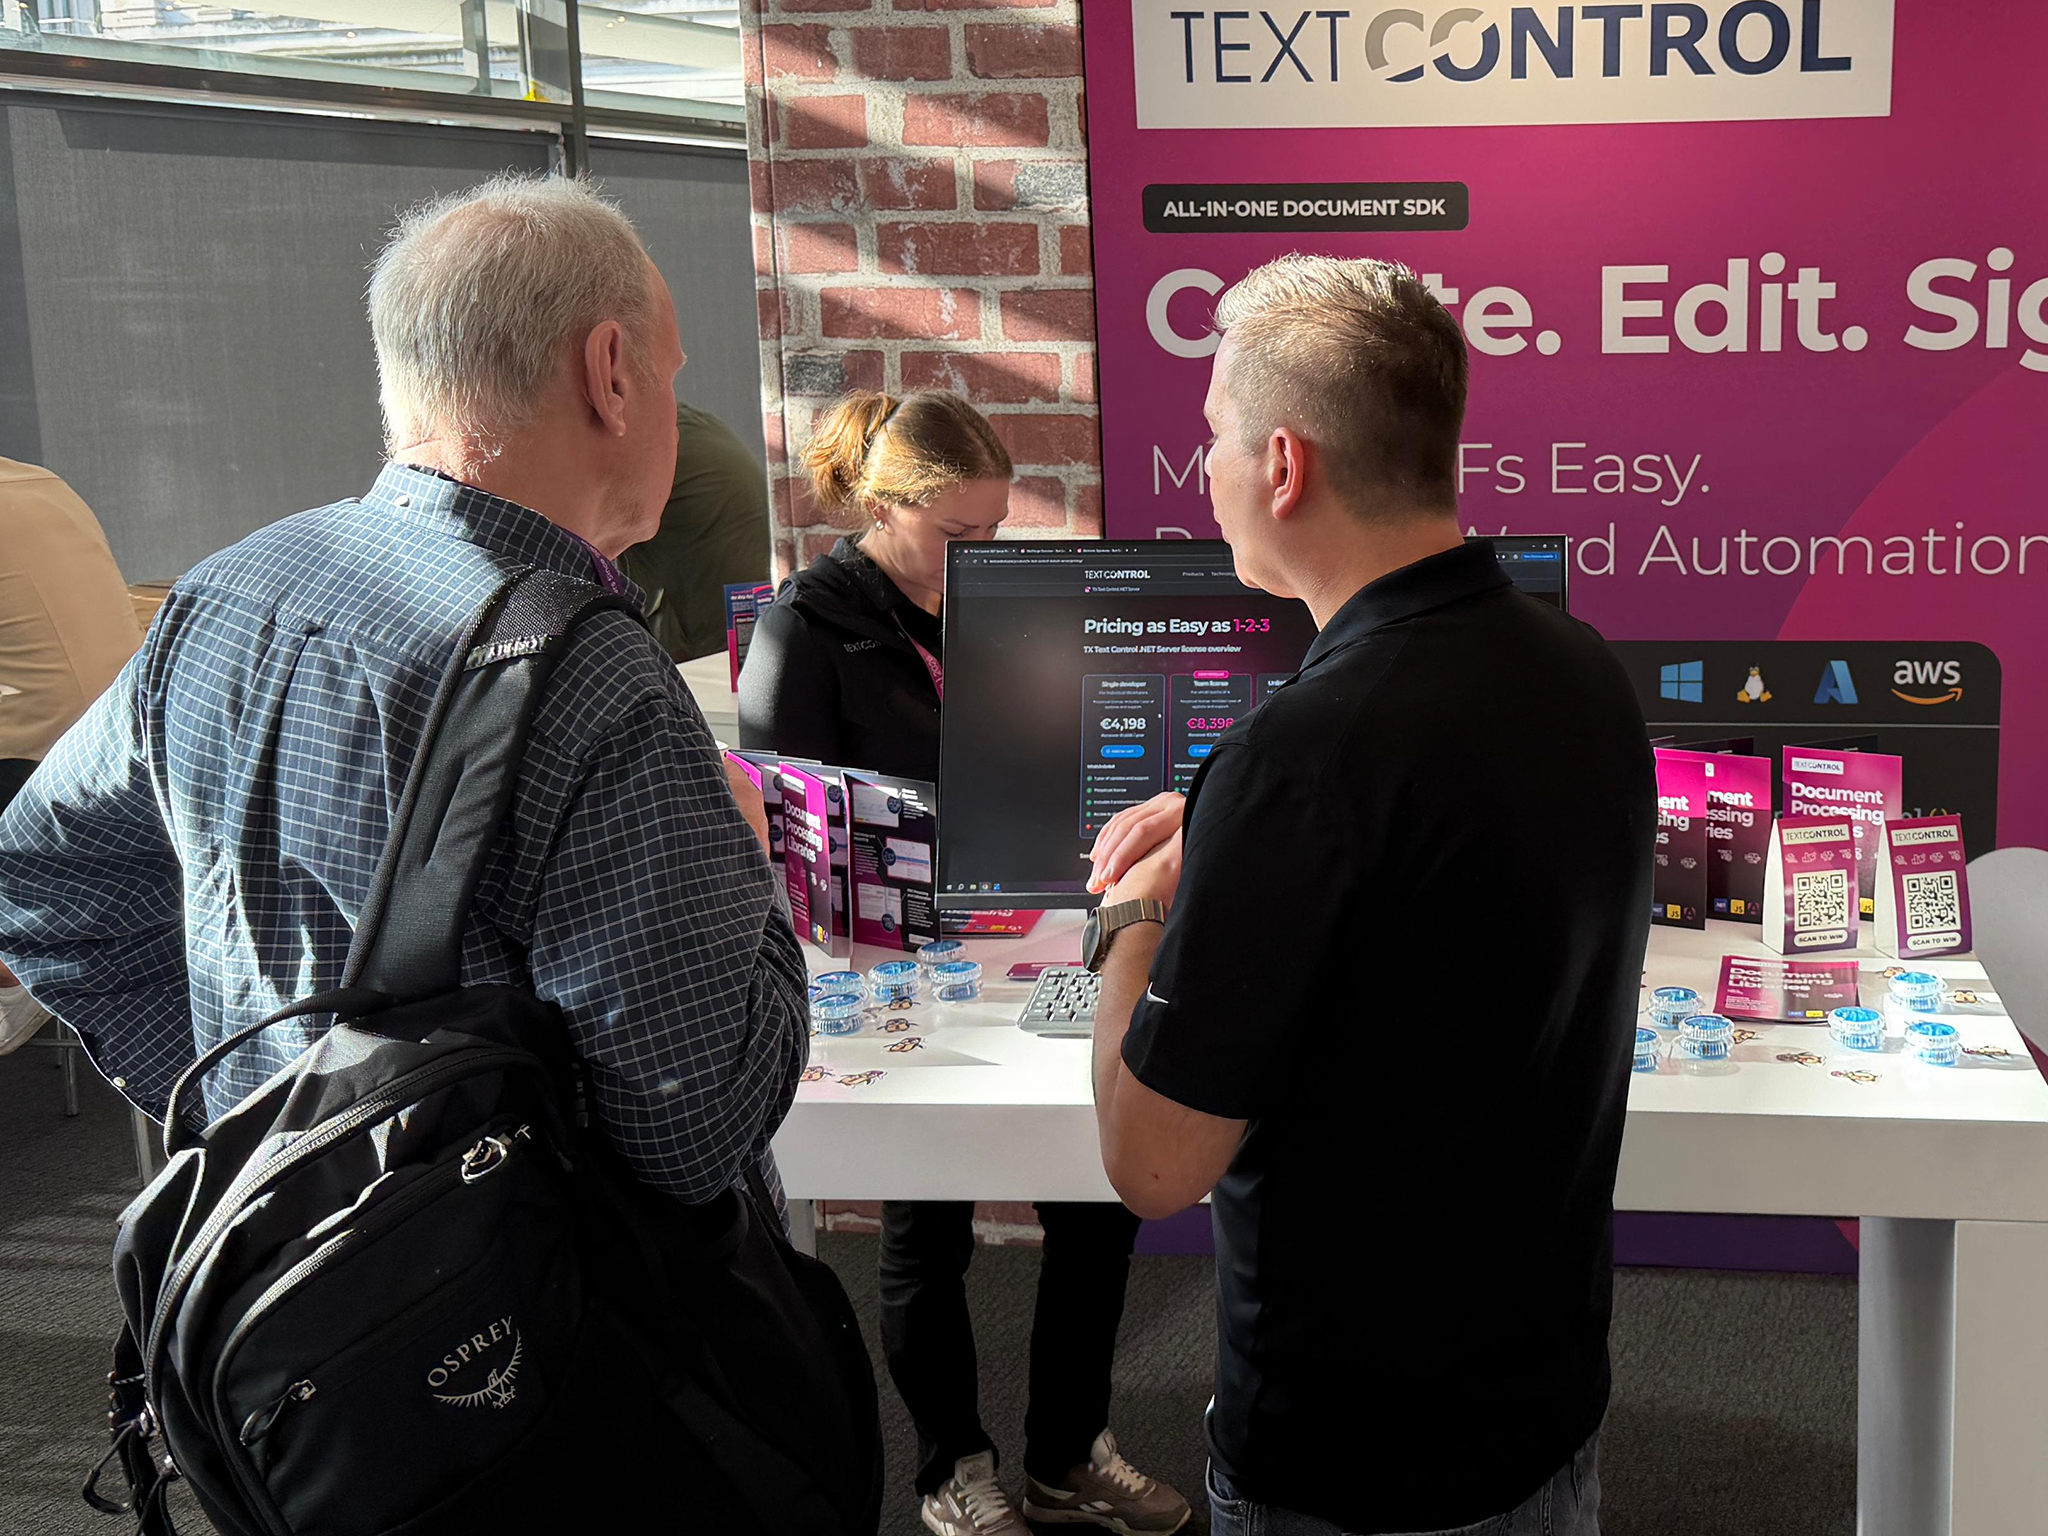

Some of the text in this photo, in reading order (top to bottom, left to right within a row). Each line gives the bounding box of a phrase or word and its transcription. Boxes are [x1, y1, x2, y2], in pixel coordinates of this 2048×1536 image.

[1162, 198, 1447, 218] ALL-IN-ONE DOCUMENT SDK
[1601, 251, 1869, 354] Edit.
[1457, 442, 1710, 506] Fs Easy.
[1084, 618, 1271, 636] Pricing as Easy as 1-2-3
[1083, 645, 1242, 654] TX Text Control .NET Server license overview
[1893, 660, 1961, 685] aws
[1100, 717, 1146, 731] €4,198
[1706, 790, 1754, 807] ment
[1791, 782, 1884, 805] Document
[787, 834, 817, 864] Libraries
[1670, 910, 1680, 918] JS
[1734, 905, 1744, 913] JS
[1863, 904, 1872, 912] JS
[1798, 935, 1817, 943] SCAN
[1829, 933, 1843, 941] WIN
[1912, 936, 1957, 946] SCAN TO WIN
[1729, 974, 1834, 986] Processing
[1730, 967, 1833, 979] Document
[1728, 980, 1811, 991] Libraries
[428, 1315, 512, 1388] OSPREY
